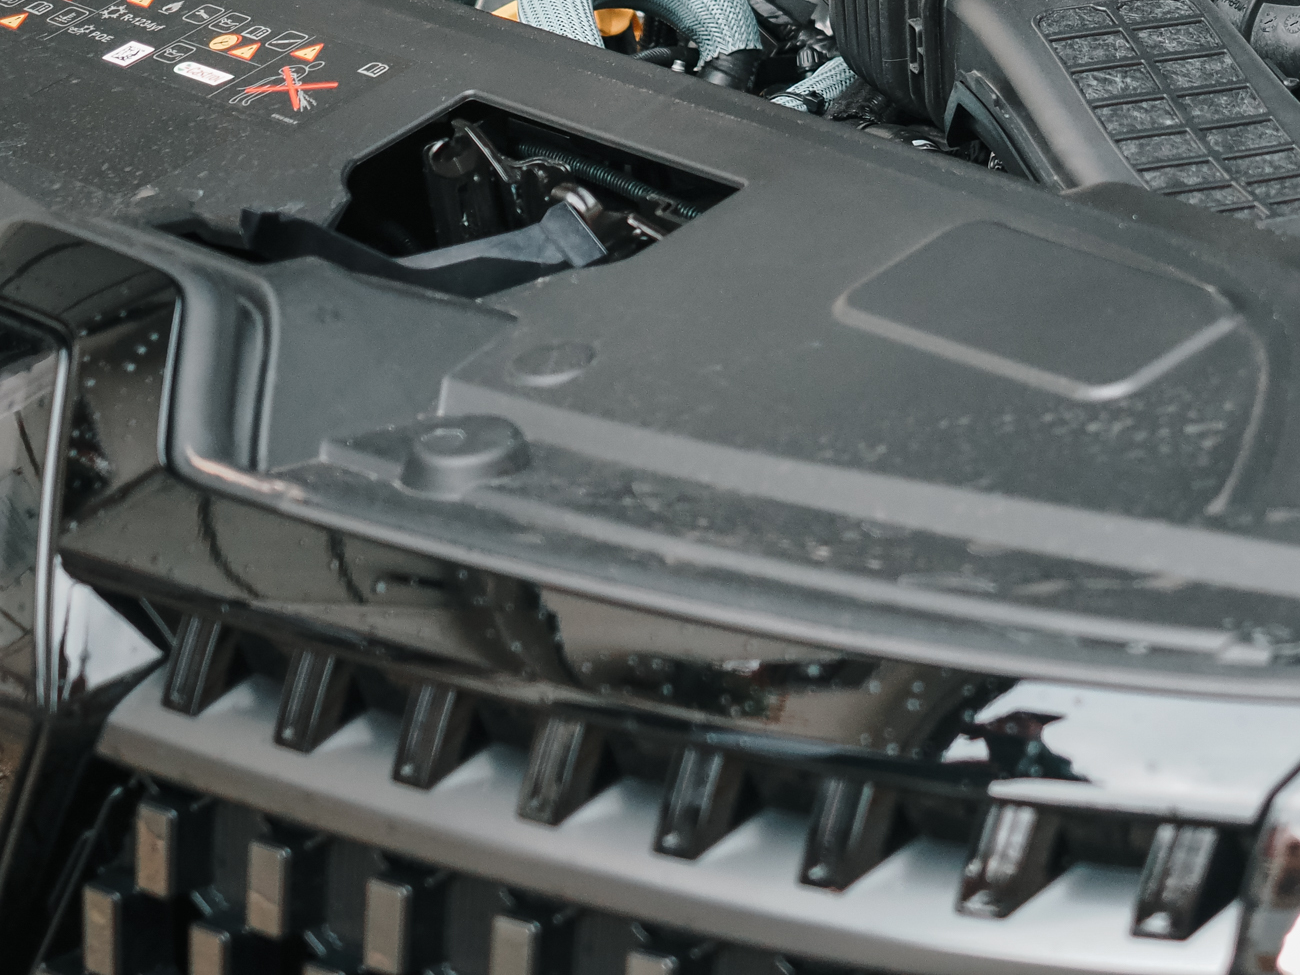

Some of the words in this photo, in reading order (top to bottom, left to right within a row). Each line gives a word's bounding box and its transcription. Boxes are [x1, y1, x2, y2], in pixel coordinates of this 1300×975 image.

[121, 14, 165, 31] R-1234yf
[90, 31, 114, 42] POE
[186, 67, 224, 82] Castrol
